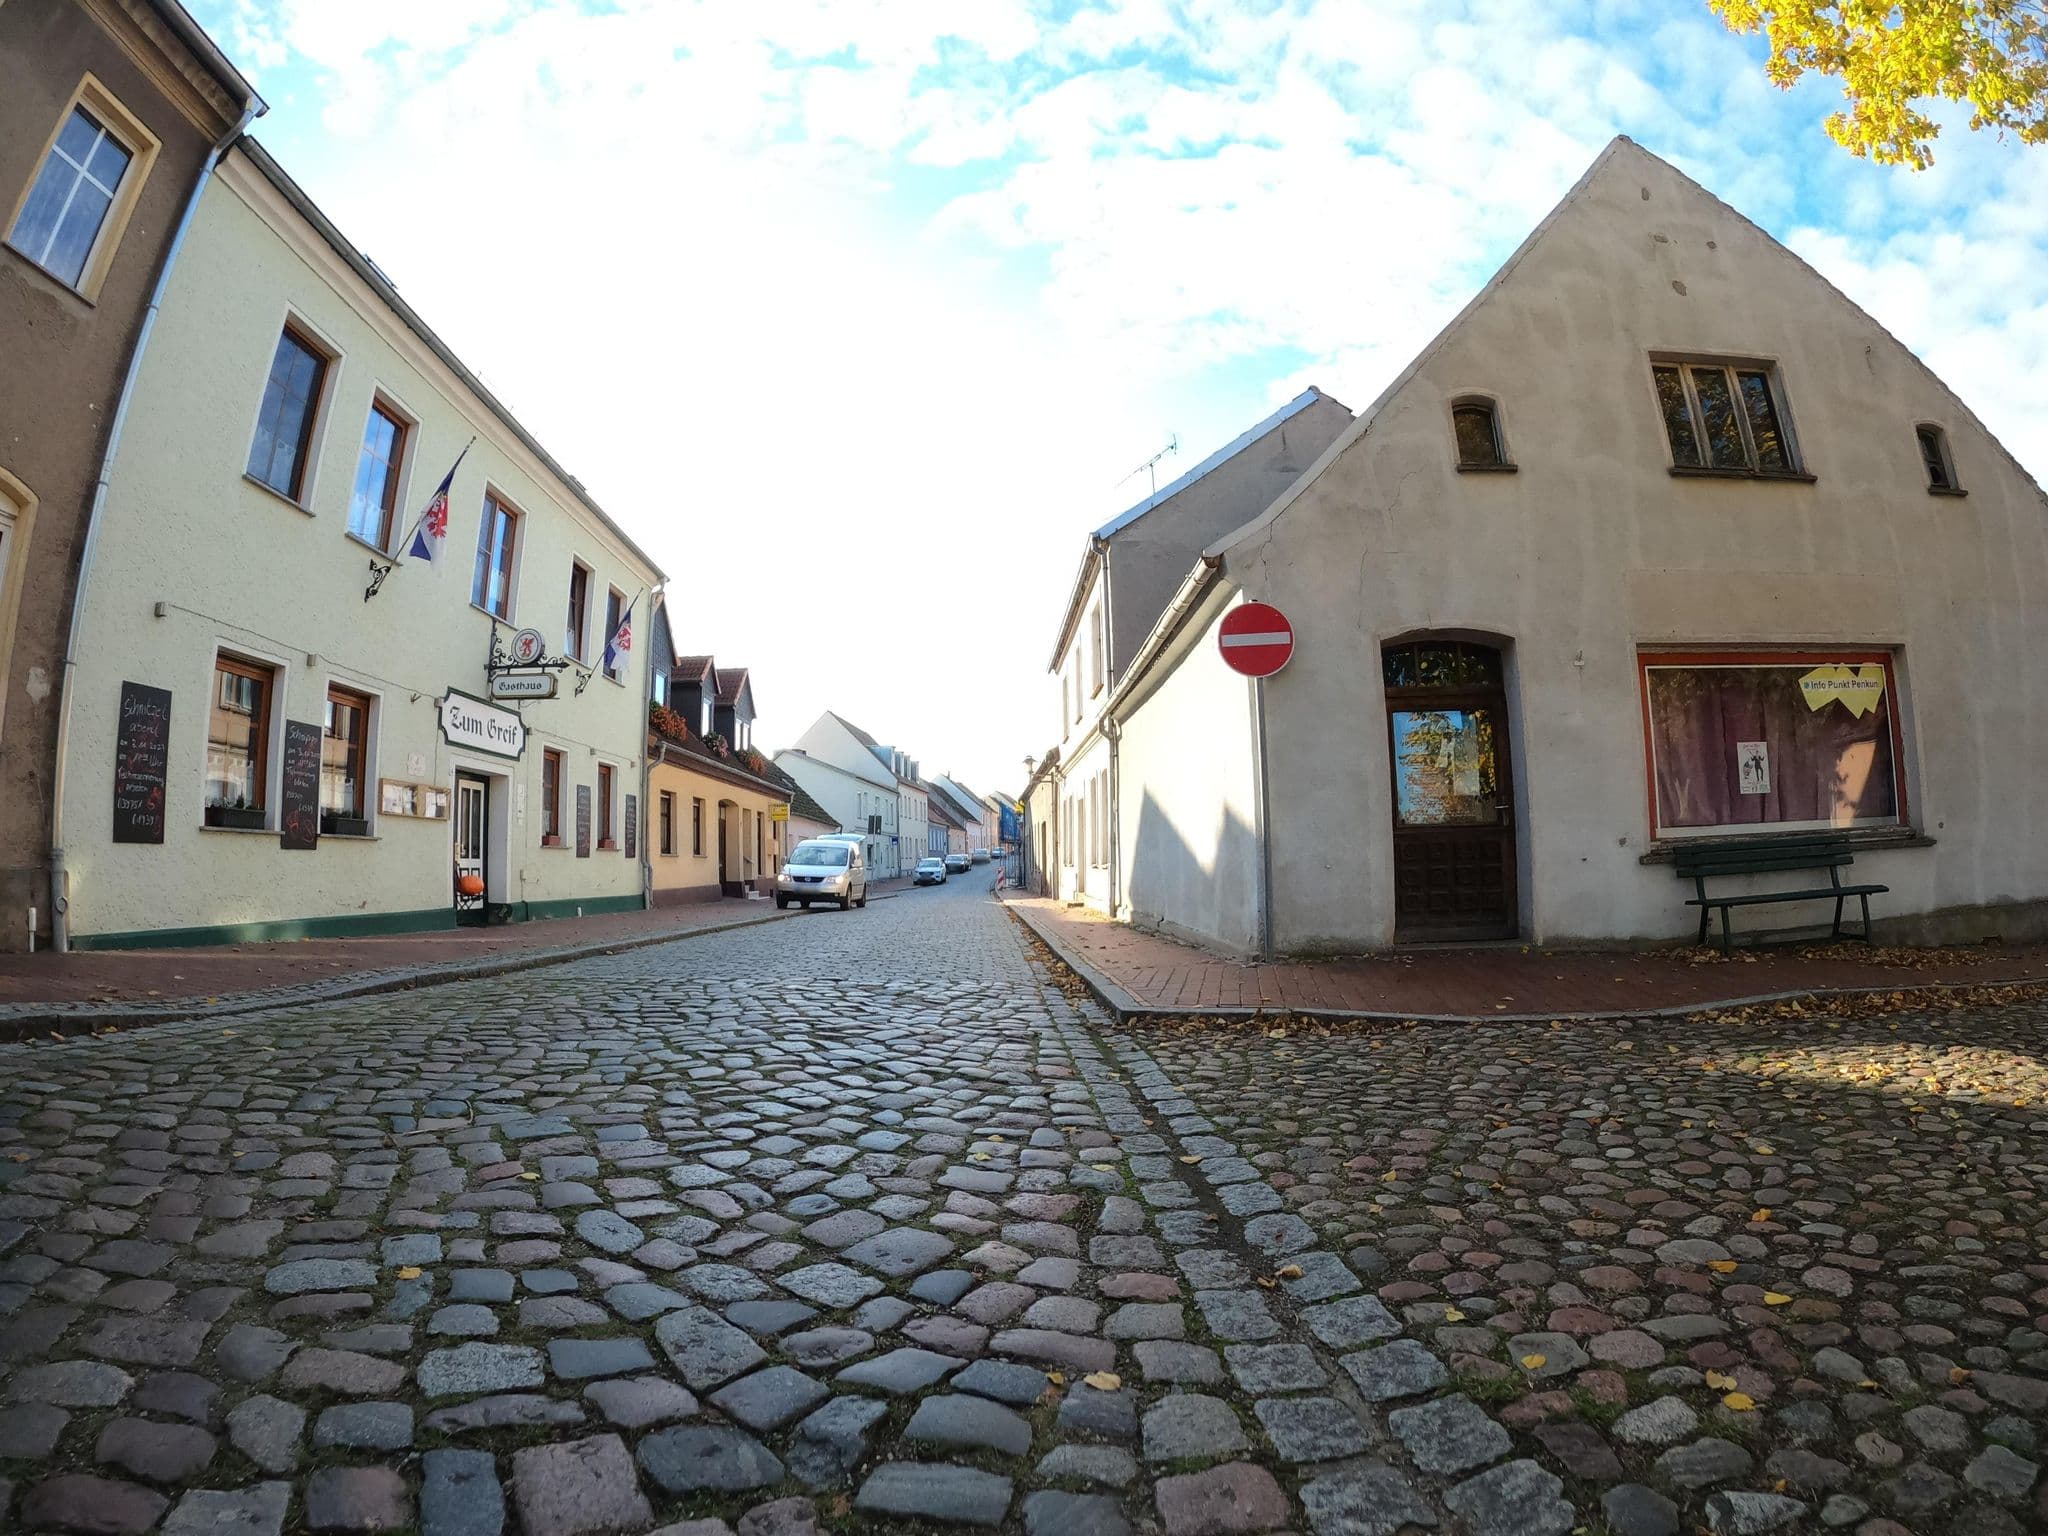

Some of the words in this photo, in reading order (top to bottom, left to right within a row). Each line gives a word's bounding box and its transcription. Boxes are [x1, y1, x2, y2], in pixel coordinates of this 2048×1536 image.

[498, 681, 542, 691] Gasthaus
[1810, 681, 1826, 689] Info
[1828, 680, 1850, 688] Punkt
[1852, 680, 1878, 688] Penkun
[450, 706, 483, 736] Zum
[487, 718, 518, 745] Greif
